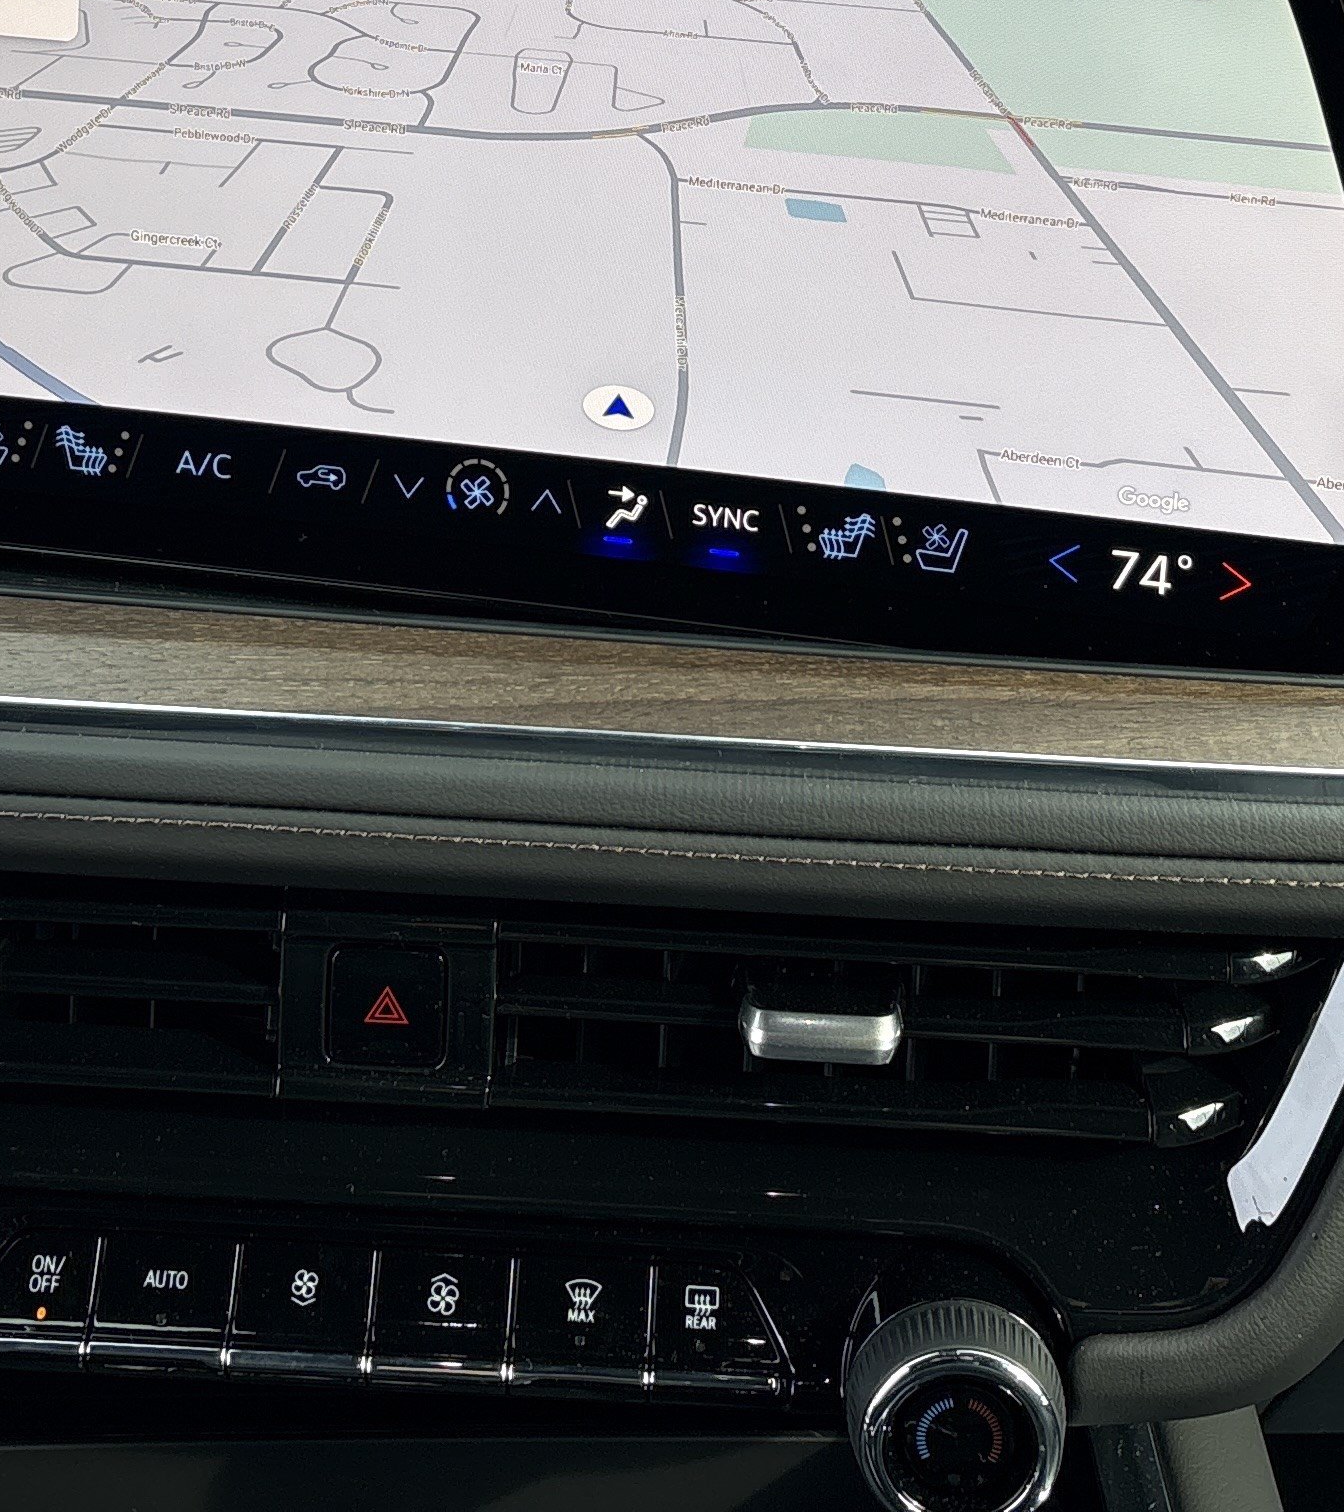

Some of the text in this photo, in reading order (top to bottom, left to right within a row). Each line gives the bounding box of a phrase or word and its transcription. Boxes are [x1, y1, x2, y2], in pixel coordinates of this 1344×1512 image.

[375, 34, 417, 51] Foxpointe
[194, 61, 222, 71] Bristol
[7, 87, 22, 100] Rd
[343, 86, 387, 99] Yorkshire
[179, 104, 213, 118] Peace
[215, 107, 231, 119] Rd
[851, 104, 898, 114] Peace Rd
[995, 99, 1009, 115] Rd
[56, 107, 112, 153] Woodgate Dr
[353, 120, 389, 134] Peace
[391, 123, 406, 135] Rd
[662, 116, 710, 133] Peace Rd
[1024, 116, 1073, 130] Peace Rd
[174, 127, 257, 144] Pebblewood Dr
[689, 176, 785, 195] Mediterranean Dr
[1072, 177, 1118, 191] Klein Rd
[1230, 192, 1276, 207] Klein Rd
[980, 208, 1081, 229] Mediterranean Dr
[131, 229, 218, 249] Gingercreek Ct
[675, 295, 688, 371] Mercantile Dr
[176, 450, 233, 479] A/C
[1001, 449, 1080, 470] Aberdeen Ct
[1118, 485, 1191, 515] Google
[692, 504, 760, 532] SYNC
[1111, 548, 1193, 596] 74°
[32, 1254, 67, 1275] ON/
[29, 1274, 60, 1294] OFF
[143, 1270, 189, 1290] AUTO
[567, 1309, 596, 1324] MAX
[685, 1314, 717, 1331] REAR
